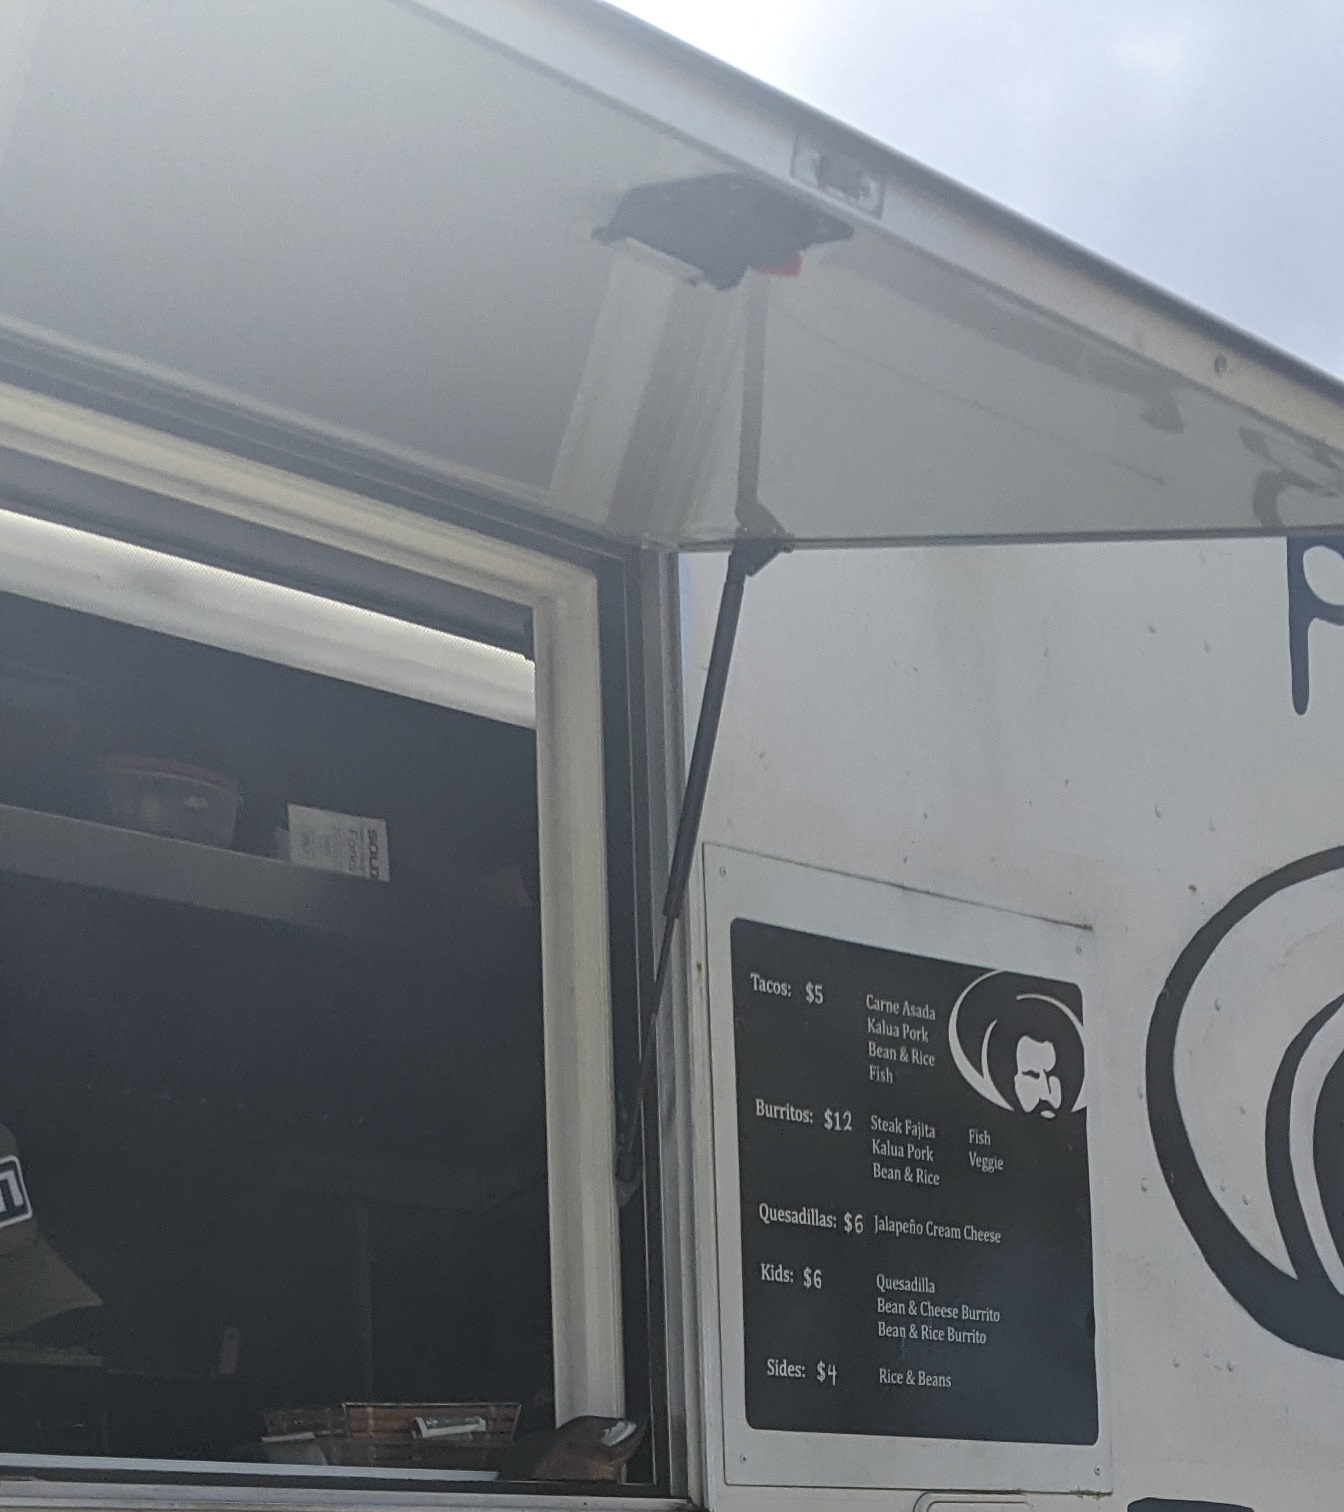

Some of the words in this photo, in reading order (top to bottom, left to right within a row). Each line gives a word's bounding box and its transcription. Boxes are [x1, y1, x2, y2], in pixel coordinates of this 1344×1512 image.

[750, 972, 792, 998] Tacos:
[805, 981, 824, 1004] $5
[866, 995, 899, 1014] Carne
[902, 1000, 936, 1020] Asada
[867, 1018, 899, 1038] Kalua
[902, 1023, 929, 1043] Pork
[868, 1042, 896, 1062] Bean
[899, 1047, 909, 1062] &
[911, 1049, 936, 1067] Rice
[869, 1065, 893, 1084] Fish
[755, 1099, 813, 1124] Burritos:
[824, 1108, 853, 1132] $12
[871, 1115, 902, 1135] Steak
[905, 1119, 936, 1141] Fajita
[968, 1128, 991, 1146] Fish
[872, 1139, 905, 1159] Kalua
[907, 1144, 934, 1162] Pork
[968, 1152, 1004, 1173] Veggie
[873, 1163, 902, 1183] Bean
[904, 1168, 914, 1183] &
[916, 1169, 940, 1186] Rice
[759, 1203, 837, 1229] Quesadillas:
[844, 1212, 864, 1234] $6
[874, 1215, 923, 1237] Jalapeño
[925, 1221, 961, 1240] Cream
[963, 1225, 1002, 1244] Cheese
[761, 1263, 794, 1284] Kids:
[803, 1266, 822, 1289] $6
[876, 1274, 936, 1294] Quesadilla
[877, 1298, 906, 1316] Bean
[908, 1302, 918, 1316] &
[920, 1301, 959, 1319] Cheese
[961, 1304, 1001, 1323] Burrito
[878, 1322, 906, 1339] Bean
[908, 1325, 919, 1339] &
[920, 1325, 945, 1341] Rice
[947, 1326, 987, 1345] Burrito
[766, 1358, 806, 1378] Sides:
[816, 1360, 837, 1386] $4
[879, 1368, 903, 1385] Rice
[905, 1371, 916, 1386] &
[918, 1371, 952, 1388] Beans
